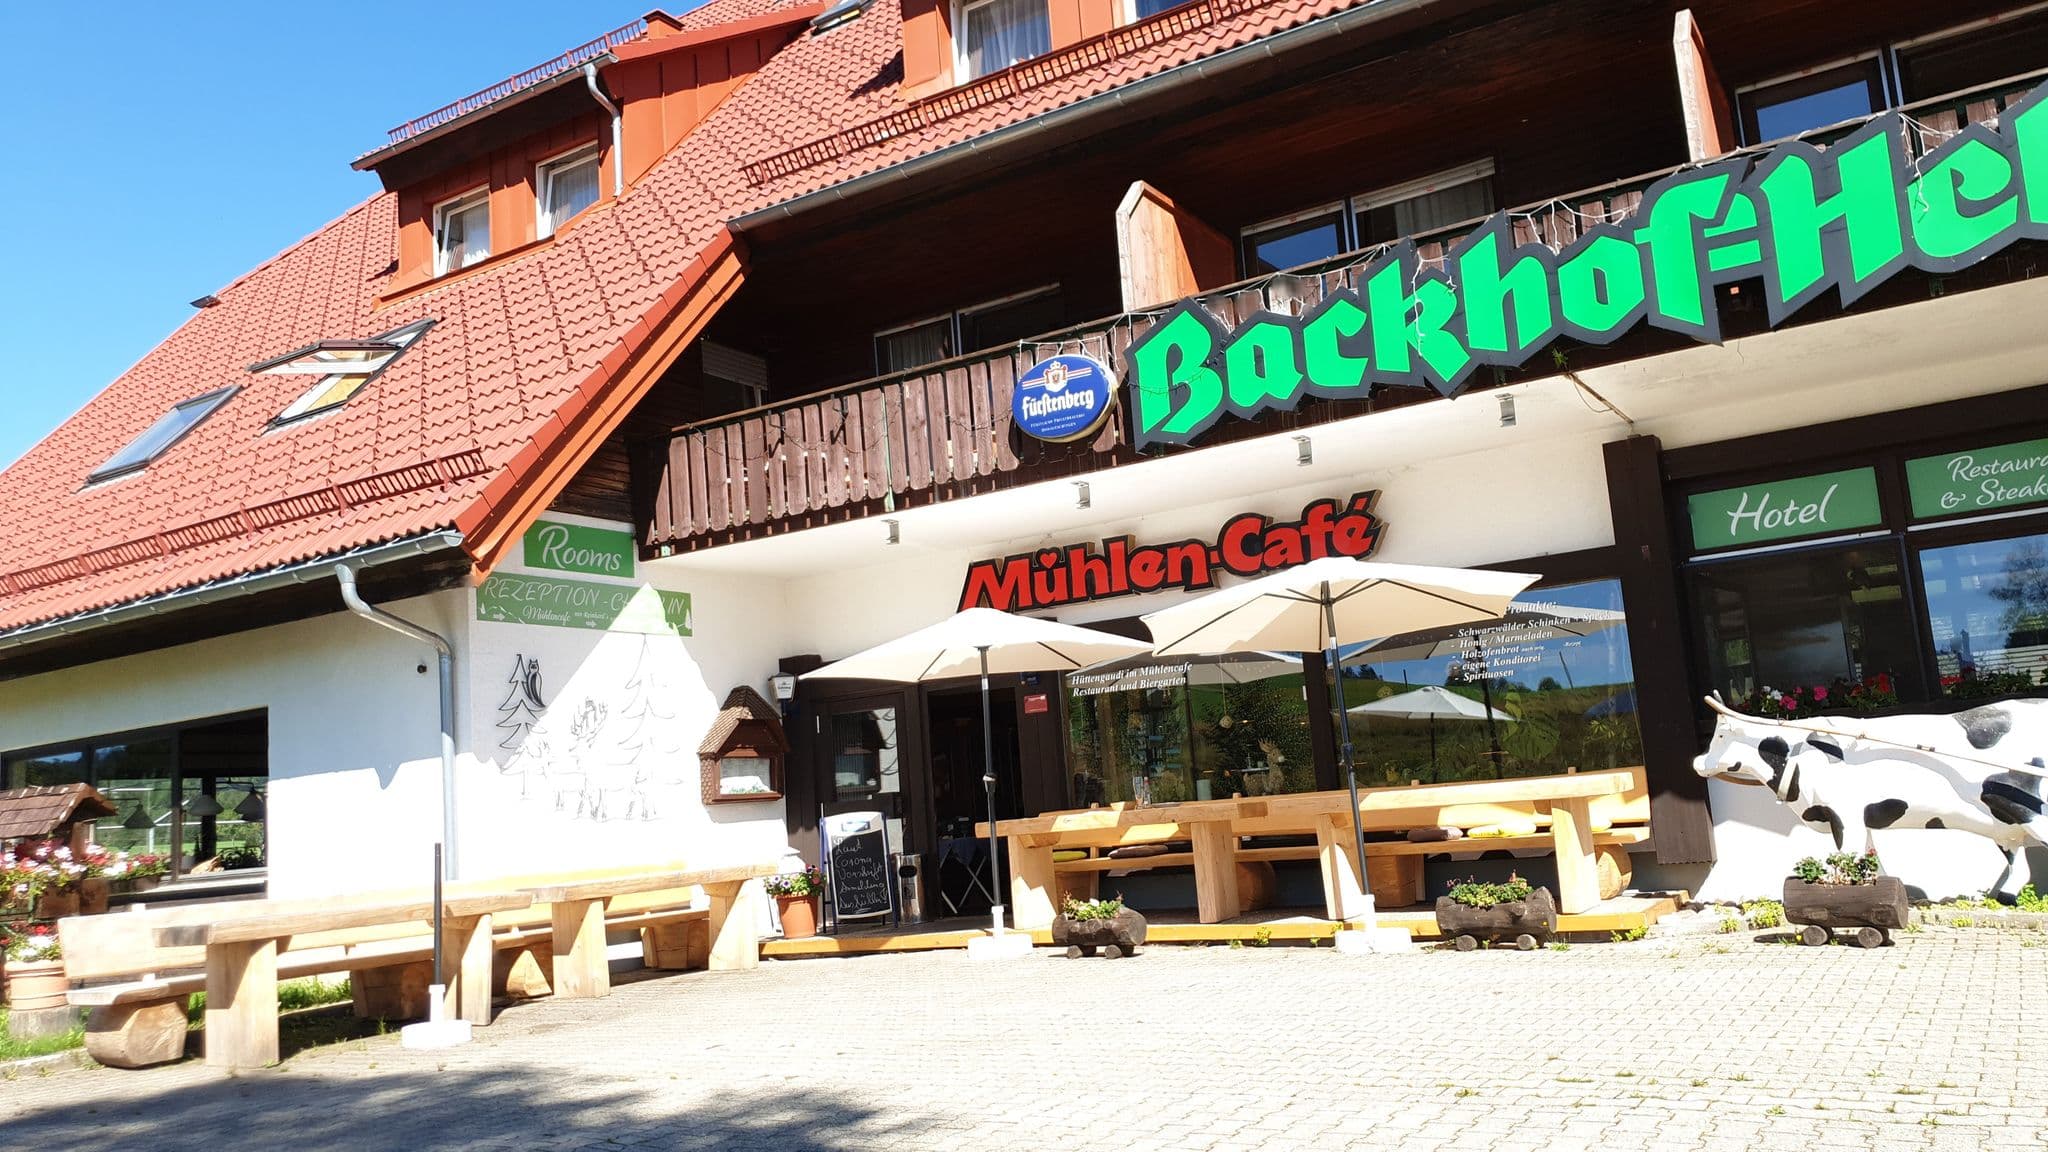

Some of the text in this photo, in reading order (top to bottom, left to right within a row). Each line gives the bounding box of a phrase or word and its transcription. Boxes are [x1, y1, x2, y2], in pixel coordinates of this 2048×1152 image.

[1022, 389, 1095, 420] Fürstenberg
[1941, 474, 2048, 509] & Steak
[1727, 484, 1838, 536] Hotel
[538, 525, 622, 572] Rooms
[1458, 622, 1525, 638] Schwarzwälder
[1528, 617, 1571, 629] Schinken
[1460, 638, 1488, 649] Honig
[1495, 630, 1553, 644] Marmeladen
[1461, 645, 1520, 659] Holzofenbrot
[1462, 660, 1490, 671] eigene
[1493, 653, 1541, 667] Konditorei
[1072, 661, 1192, 685] Hüttengaudi im Mühlencafe
[1463, 669, 1514, 682] Spirituosen
[1073, 676, 1186, 697] Restaurant und Biergarten
